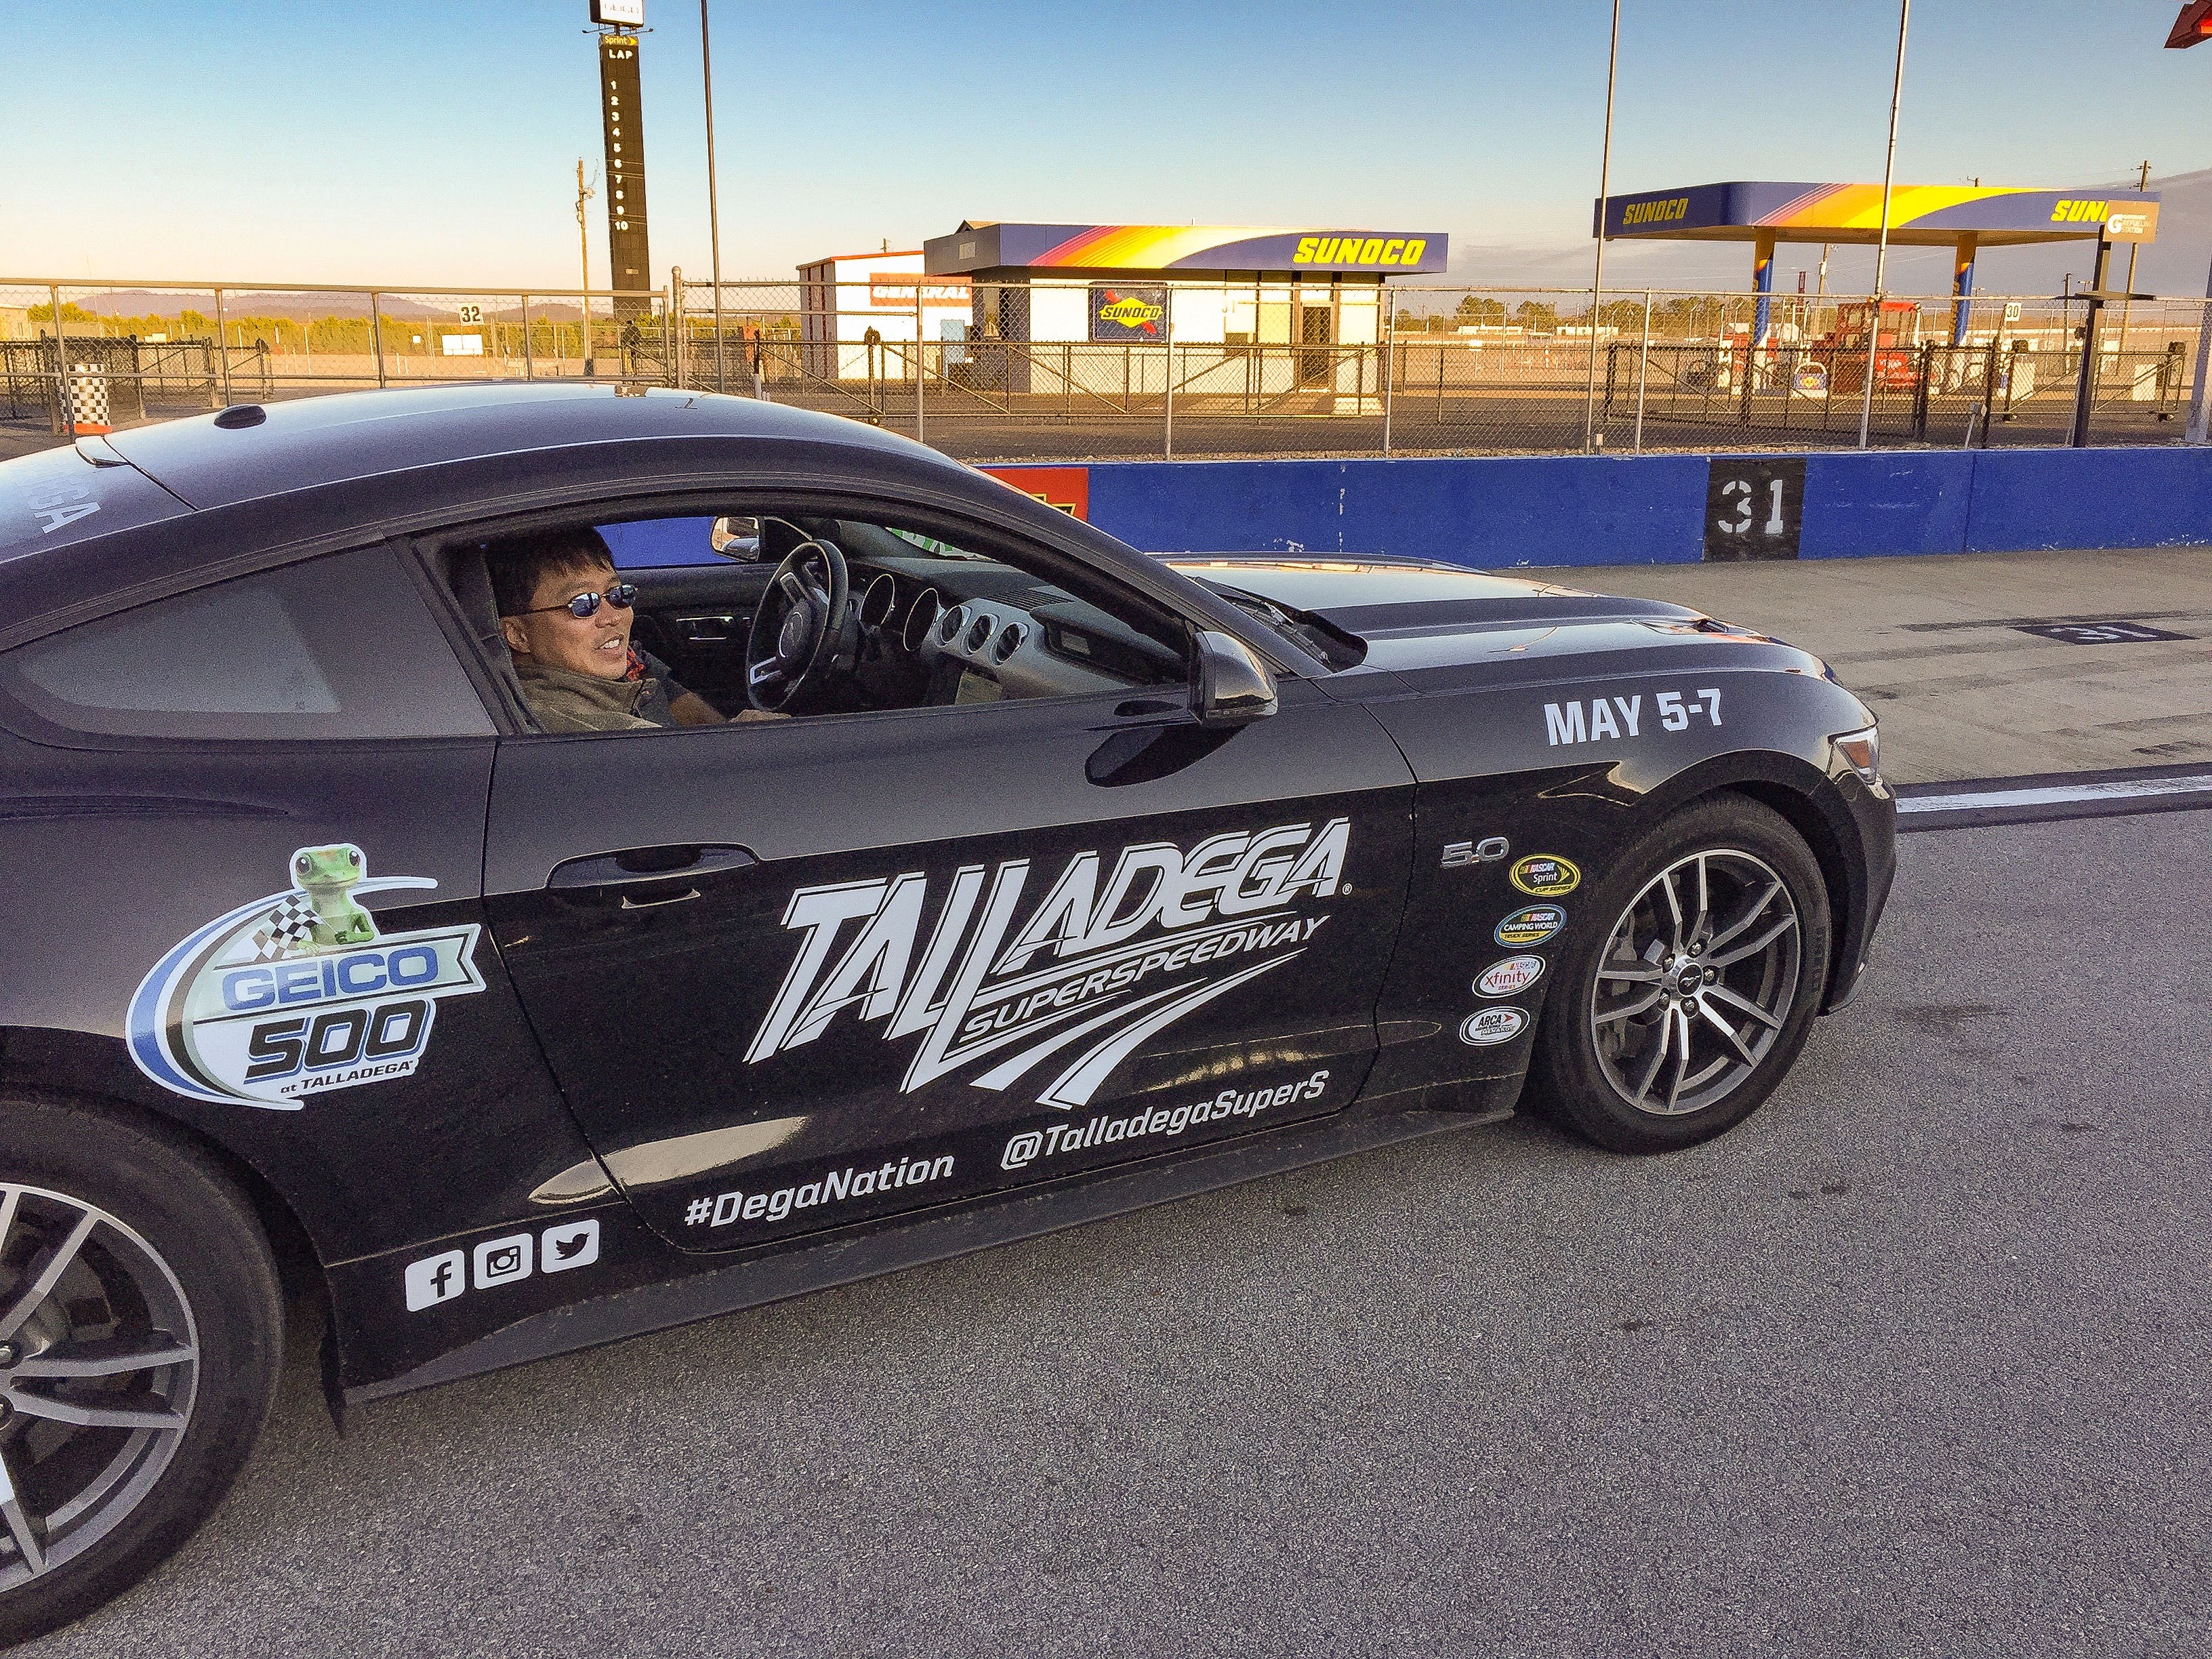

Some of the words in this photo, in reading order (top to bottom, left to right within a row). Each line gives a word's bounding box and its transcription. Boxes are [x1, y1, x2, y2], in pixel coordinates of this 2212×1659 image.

[605, 35, 628, 45] Sprint
[609, 49, 633, 59] LAP
[611, 80, 617, 89] 1
[611, 96, 619, 106] 2
[611, 111, 619, 121] 3
[612, 127, 620, 137] 4
[613, 142, 621, 152] 5
[614, 159, 622, 168] 6
[615, 174, 623, 184] 7
[615, 190, 624, 199] 8
[616, 205, 625, 215] 9
[1622, 198, 1689, 226] SUNOCO
[615, 221, 629, 230] 10
[1292, 237, 1427, 266] SUNOCO
[461, 306, 480, 322] 32
[1103, 306, 1160, 318] SUNOCO
[2007, 305, 2019, 318] 30
[1718, 479, 1784, 535] 31
[2049, 625, 2158, 641] 31
[1543, 695, 1641, 746] MAY
[1656, 688, 1723, 732] 5-7
[1530, 862, 1557, 873] NASCAR
[1533, 872, 1558, 884] Sprint
[1530, 912, 1556, 922] NASCAR
[1503, 922, 1534, 932] CAMPING
[1534, 921, 1559, 930] WORLD
[743, 816, 1351, 1093] TALLADEGA
[221, 945, 438, 1011] GEICO
[959, 916, 1330, 1044] SUPERSPEEDWAY
[1484, 970, 1532, 988] xfinity
[1477, 1014, 1502, 1027] ARCA
[243, 999, 432, 1086] 500
[280, 1084, 297, 1093] at
[300, 1061, 411, 1089] TALLADEGA
[1000, 1069, 1330, 1170] @TalladegaSuperS
[684, 1151, 955, 1228] #DegaNation
